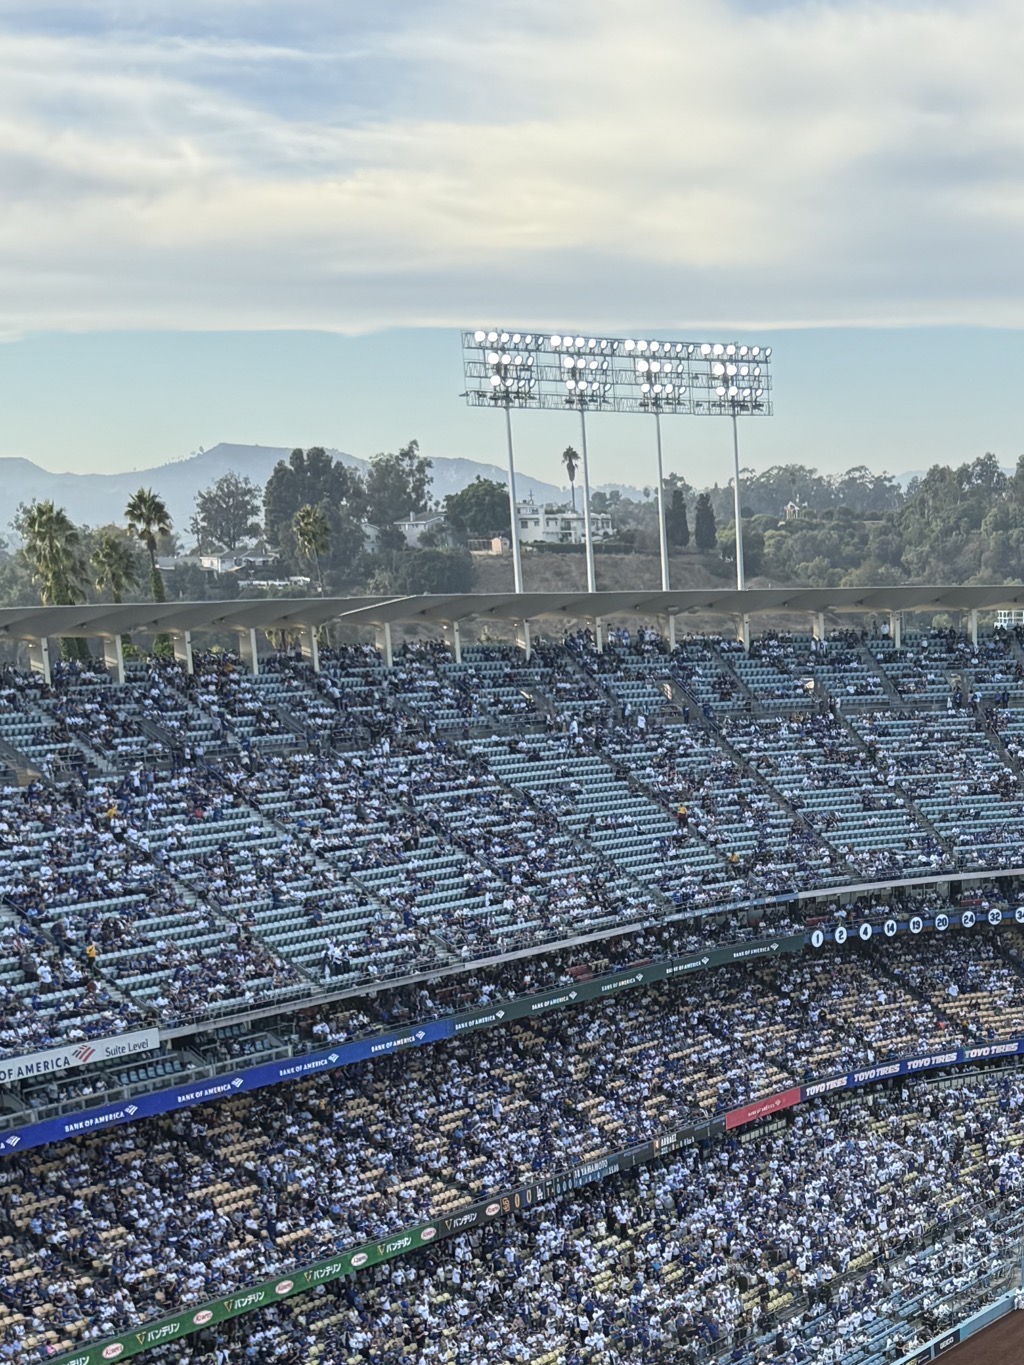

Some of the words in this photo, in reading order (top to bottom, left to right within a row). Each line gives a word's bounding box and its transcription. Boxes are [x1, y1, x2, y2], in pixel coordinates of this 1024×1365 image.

[937, 917, 948, 927] 20
[963, 914, 974, 924] 24
[989, 912, 1000, 922] 32
[862, 926, 869, 937] 4
[886, 923, 895, 933] 14
[912, 920, 921, 930] 19
[838, 930, 844, 940] 2
[964, 1047, 989, 1059] TOYO
[990, 1042, 1019, 1055] TIRES
[17, 1056, 71, 1078] AMERICA
[105, 1044, 127, 1057] Suite
[128, 1038, 149, 1053] Level
[907, 1057, 930, 1070] TOYO
[931, 1052, 958, 1066] TIRES
[279, 1067, 294, 1077] BANK
[303, 1058, 328, 1071] AMERICA
[854, 1069, 874, 1083] TOYO
[874, 1064, 900, 1079] TIRES
[178, 1093, 195, 1103] BANK
[204, 1083, 232, 1097] AMERICA
[65, 1122, 84, 1133] BANK
[93, 1111, 125, 1126] AMERICA
